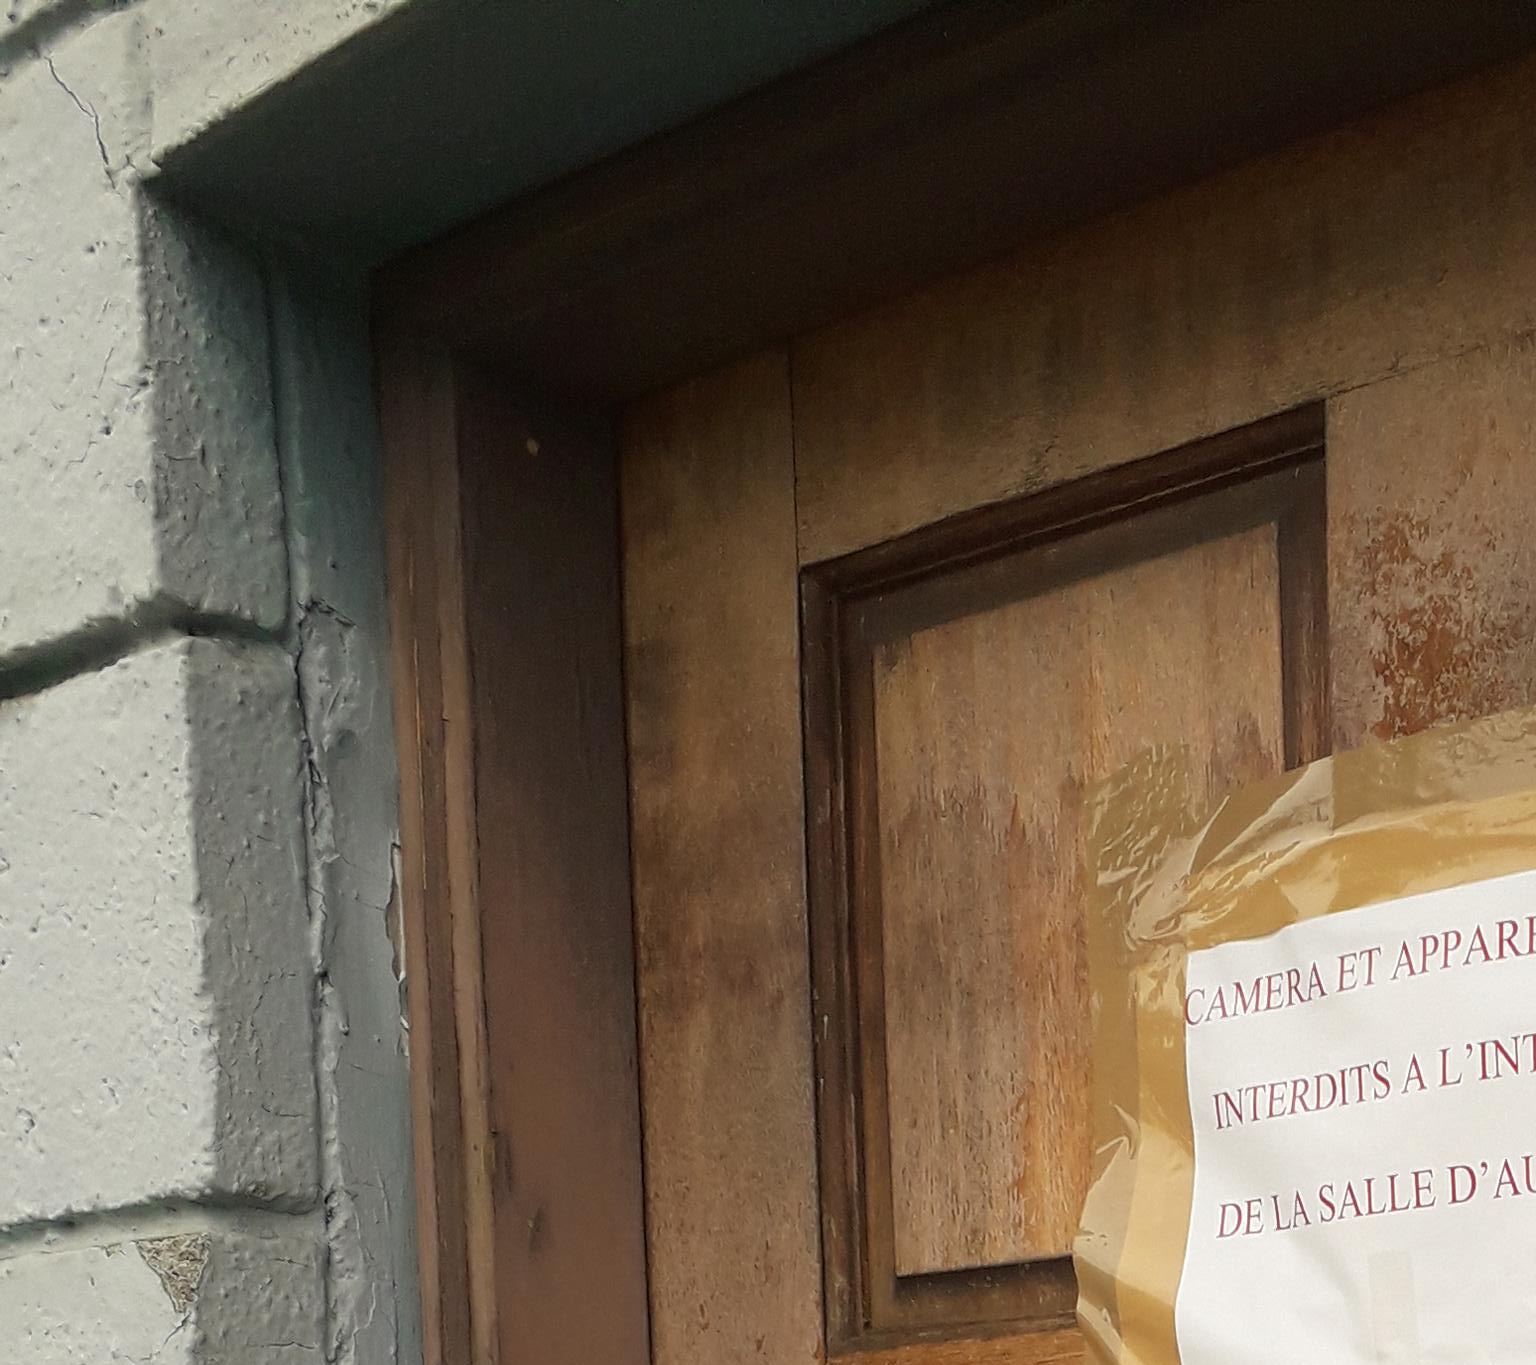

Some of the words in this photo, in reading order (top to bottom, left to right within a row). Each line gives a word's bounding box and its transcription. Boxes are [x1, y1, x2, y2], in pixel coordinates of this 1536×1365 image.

[1184, 960, 1326, 1027] CAMERA
[1336, 946, 1381, 994] ET
[1212, 1059, 1391, 1130] INTERDITS
[1401, 1053, 1428, 1094] A
[1217, 1199, 1265, 1239] DE
[1272, 1190, 1313, 1232] LA
[1318, 1169, 1436, 1224] SALLE
